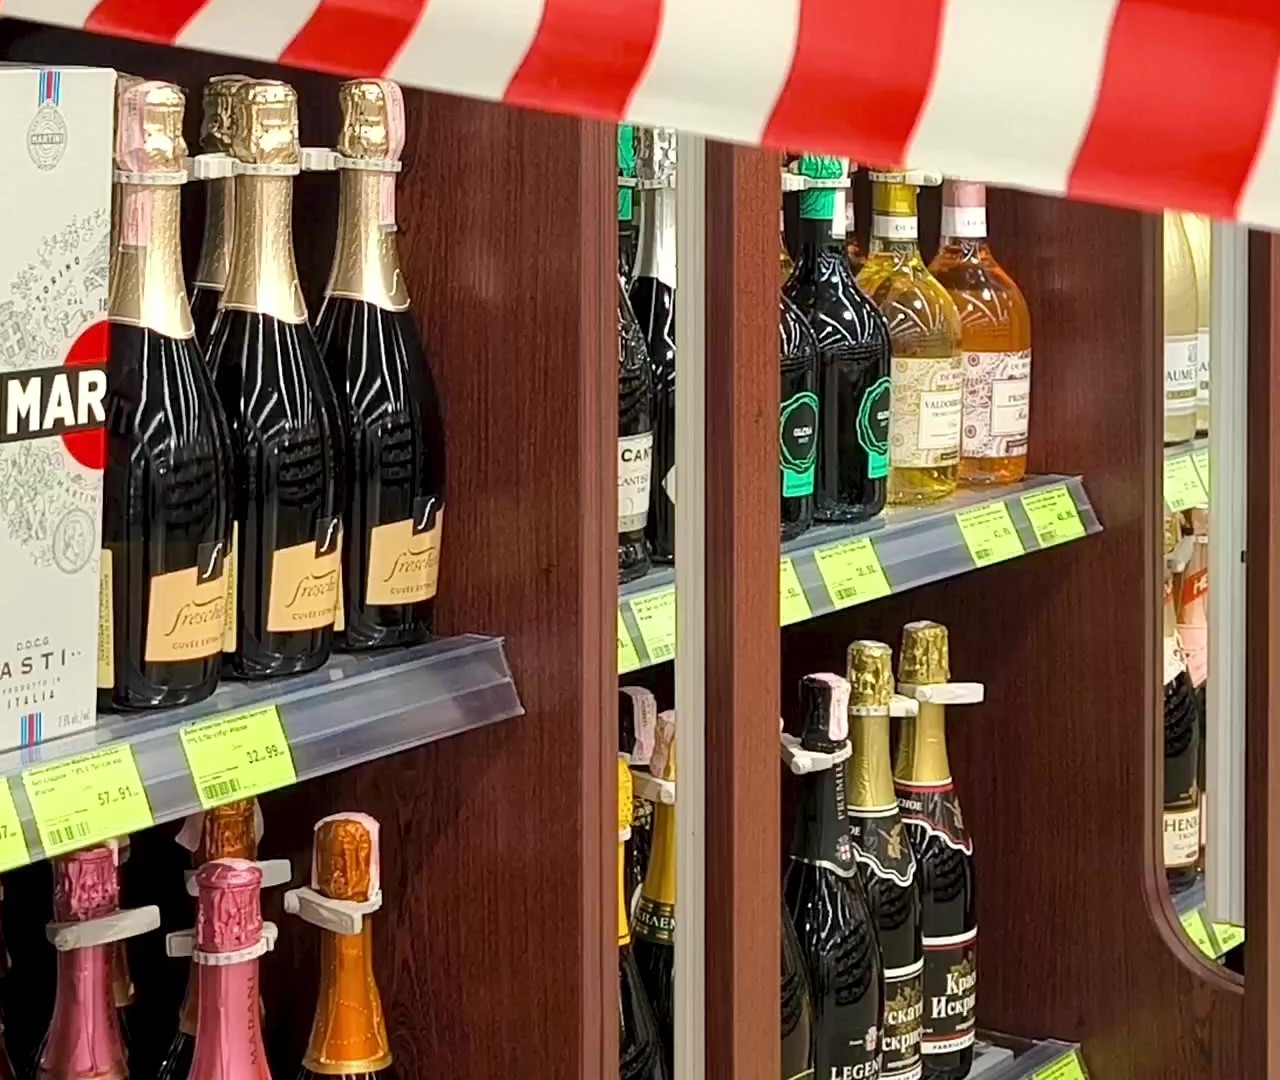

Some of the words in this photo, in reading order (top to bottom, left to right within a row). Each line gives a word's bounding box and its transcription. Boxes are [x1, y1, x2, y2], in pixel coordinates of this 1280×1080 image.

[30, 133, 65, 145] MARTINI
[35, 256, 80, 304] TORINO
[6, 369, 107, 435] MAR
[0, 649, 65, 680] ASTI
[7, 689, 54, 710] ITALIA
[98, 790, 112, 807] 57
[117, 785, 132, 800] 91
[837, 763, 846, 821] PREMIU
[249, 976, 261, 1066] MARANI
